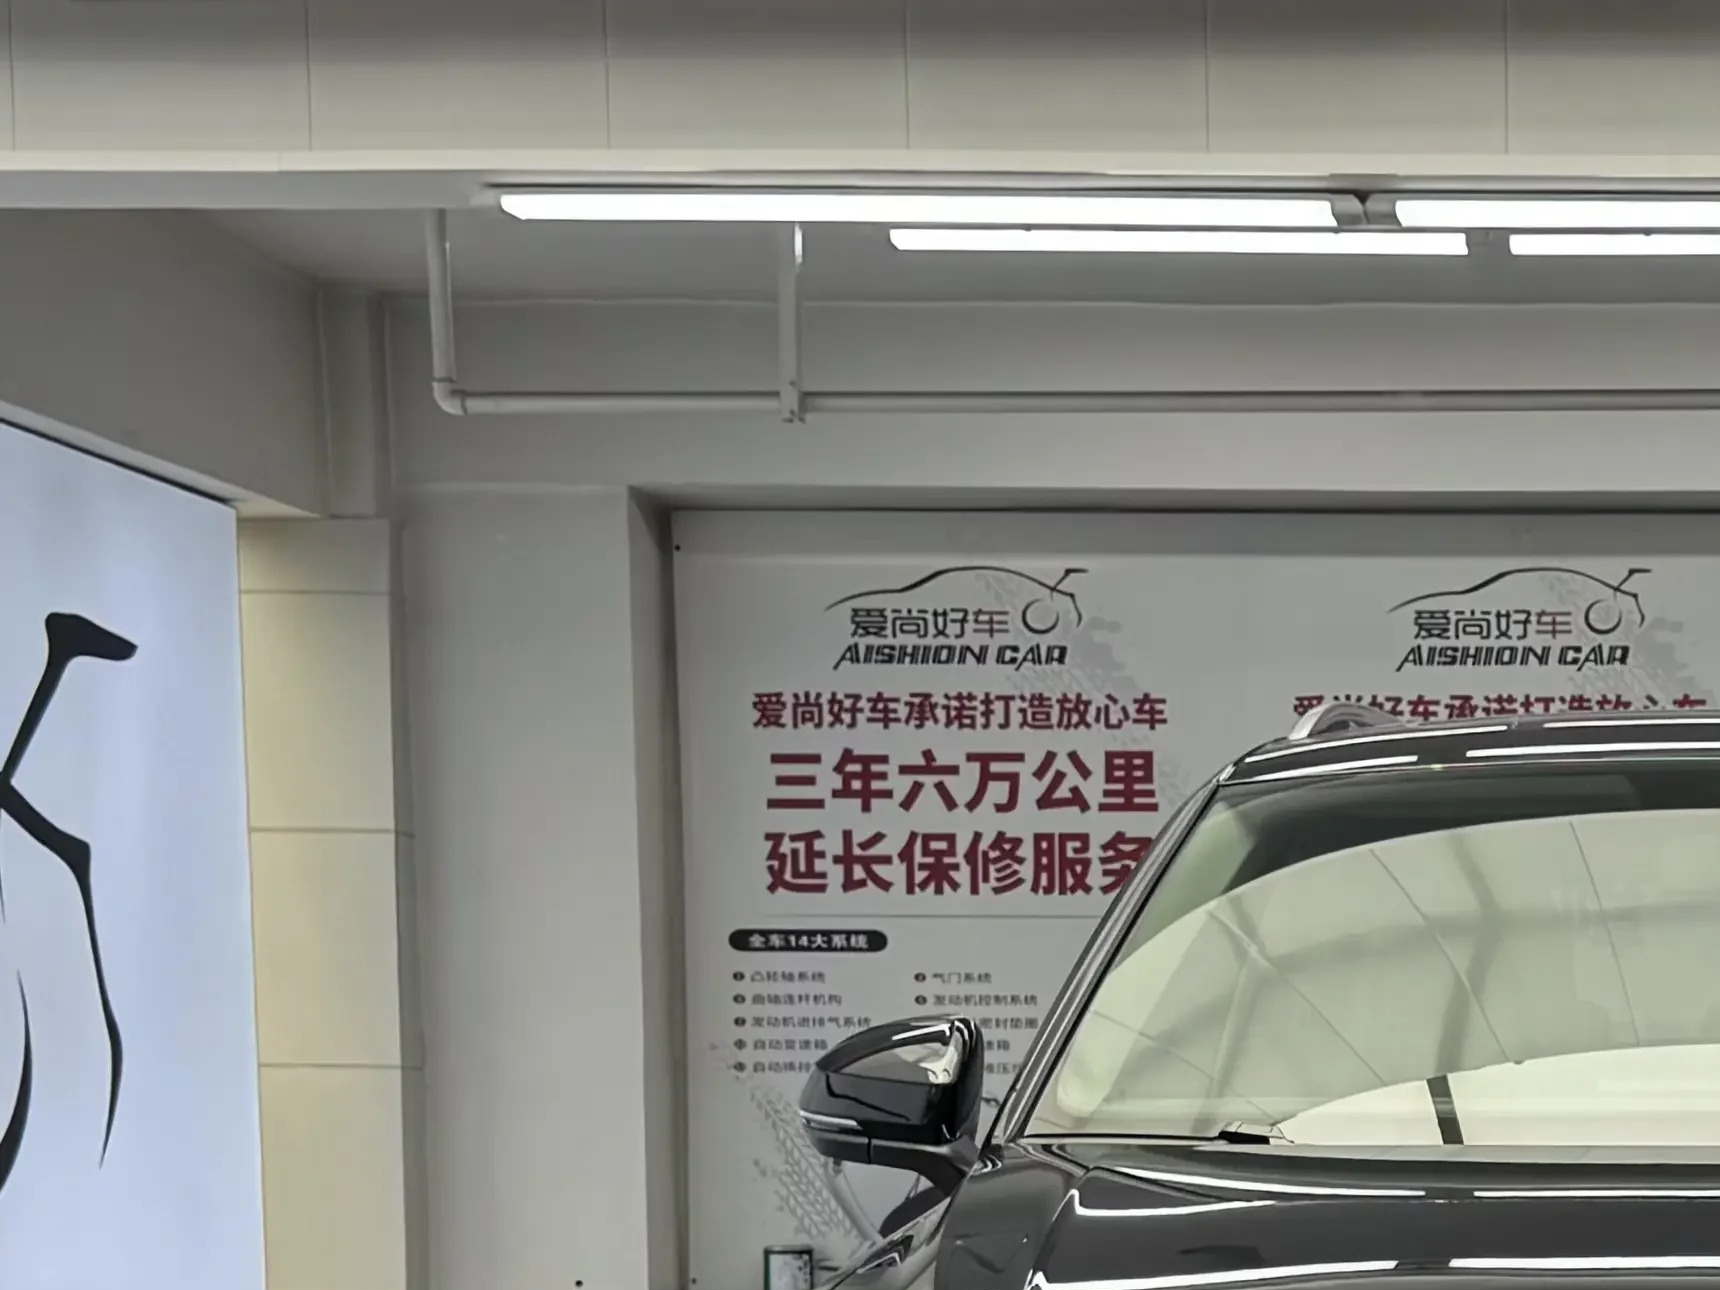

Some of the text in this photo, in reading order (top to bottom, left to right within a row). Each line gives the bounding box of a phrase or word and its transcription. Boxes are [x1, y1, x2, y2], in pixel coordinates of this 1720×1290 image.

[850, 607, 1011, 640] 爱尚好车
[1413, 609, 1573, 641] 爱尚好车
[833, 643, 1069, 672] AISHION CAR
[1395, 644, 1631, 672] AISHION CAR
[751, 691, 1168, 731] 爱尚好车承诺打造放心车
[766, 747, 1160, 815] 三年六万公里
[763, 829, 1154, 896] 延长保修服务
